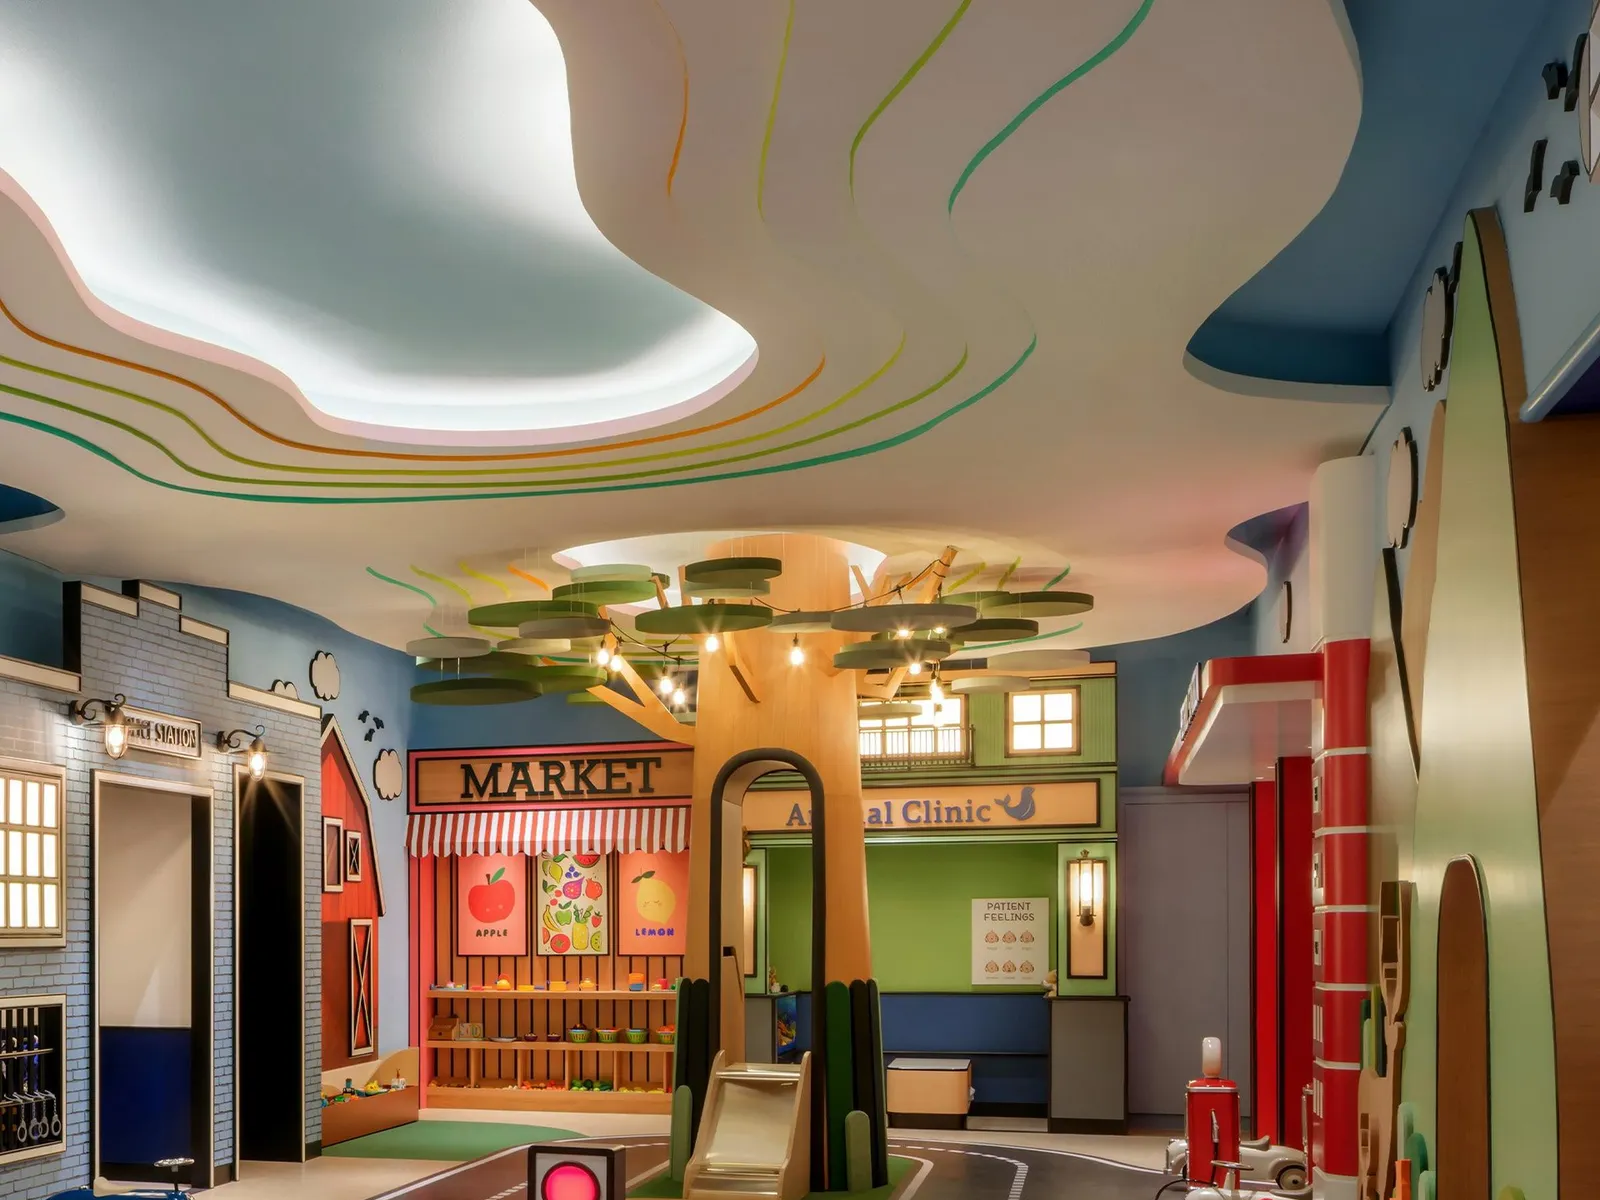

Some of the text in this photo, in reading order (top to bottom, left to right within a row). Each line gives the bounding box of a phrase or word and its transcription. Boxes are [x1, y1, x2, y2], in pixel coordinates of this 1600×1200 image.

[155, 723, 196, 748] STATION
[460, 757, 661, 799] MARKET
[786, 799, 991, 827] Aal Clinic
[987, 902, 1031, 911] PATIENT
[984, 912, 1035, 921] FEELINGS
[475, 928, 508, 937] APPLE
[635, 927, 675, 937] LEMON
